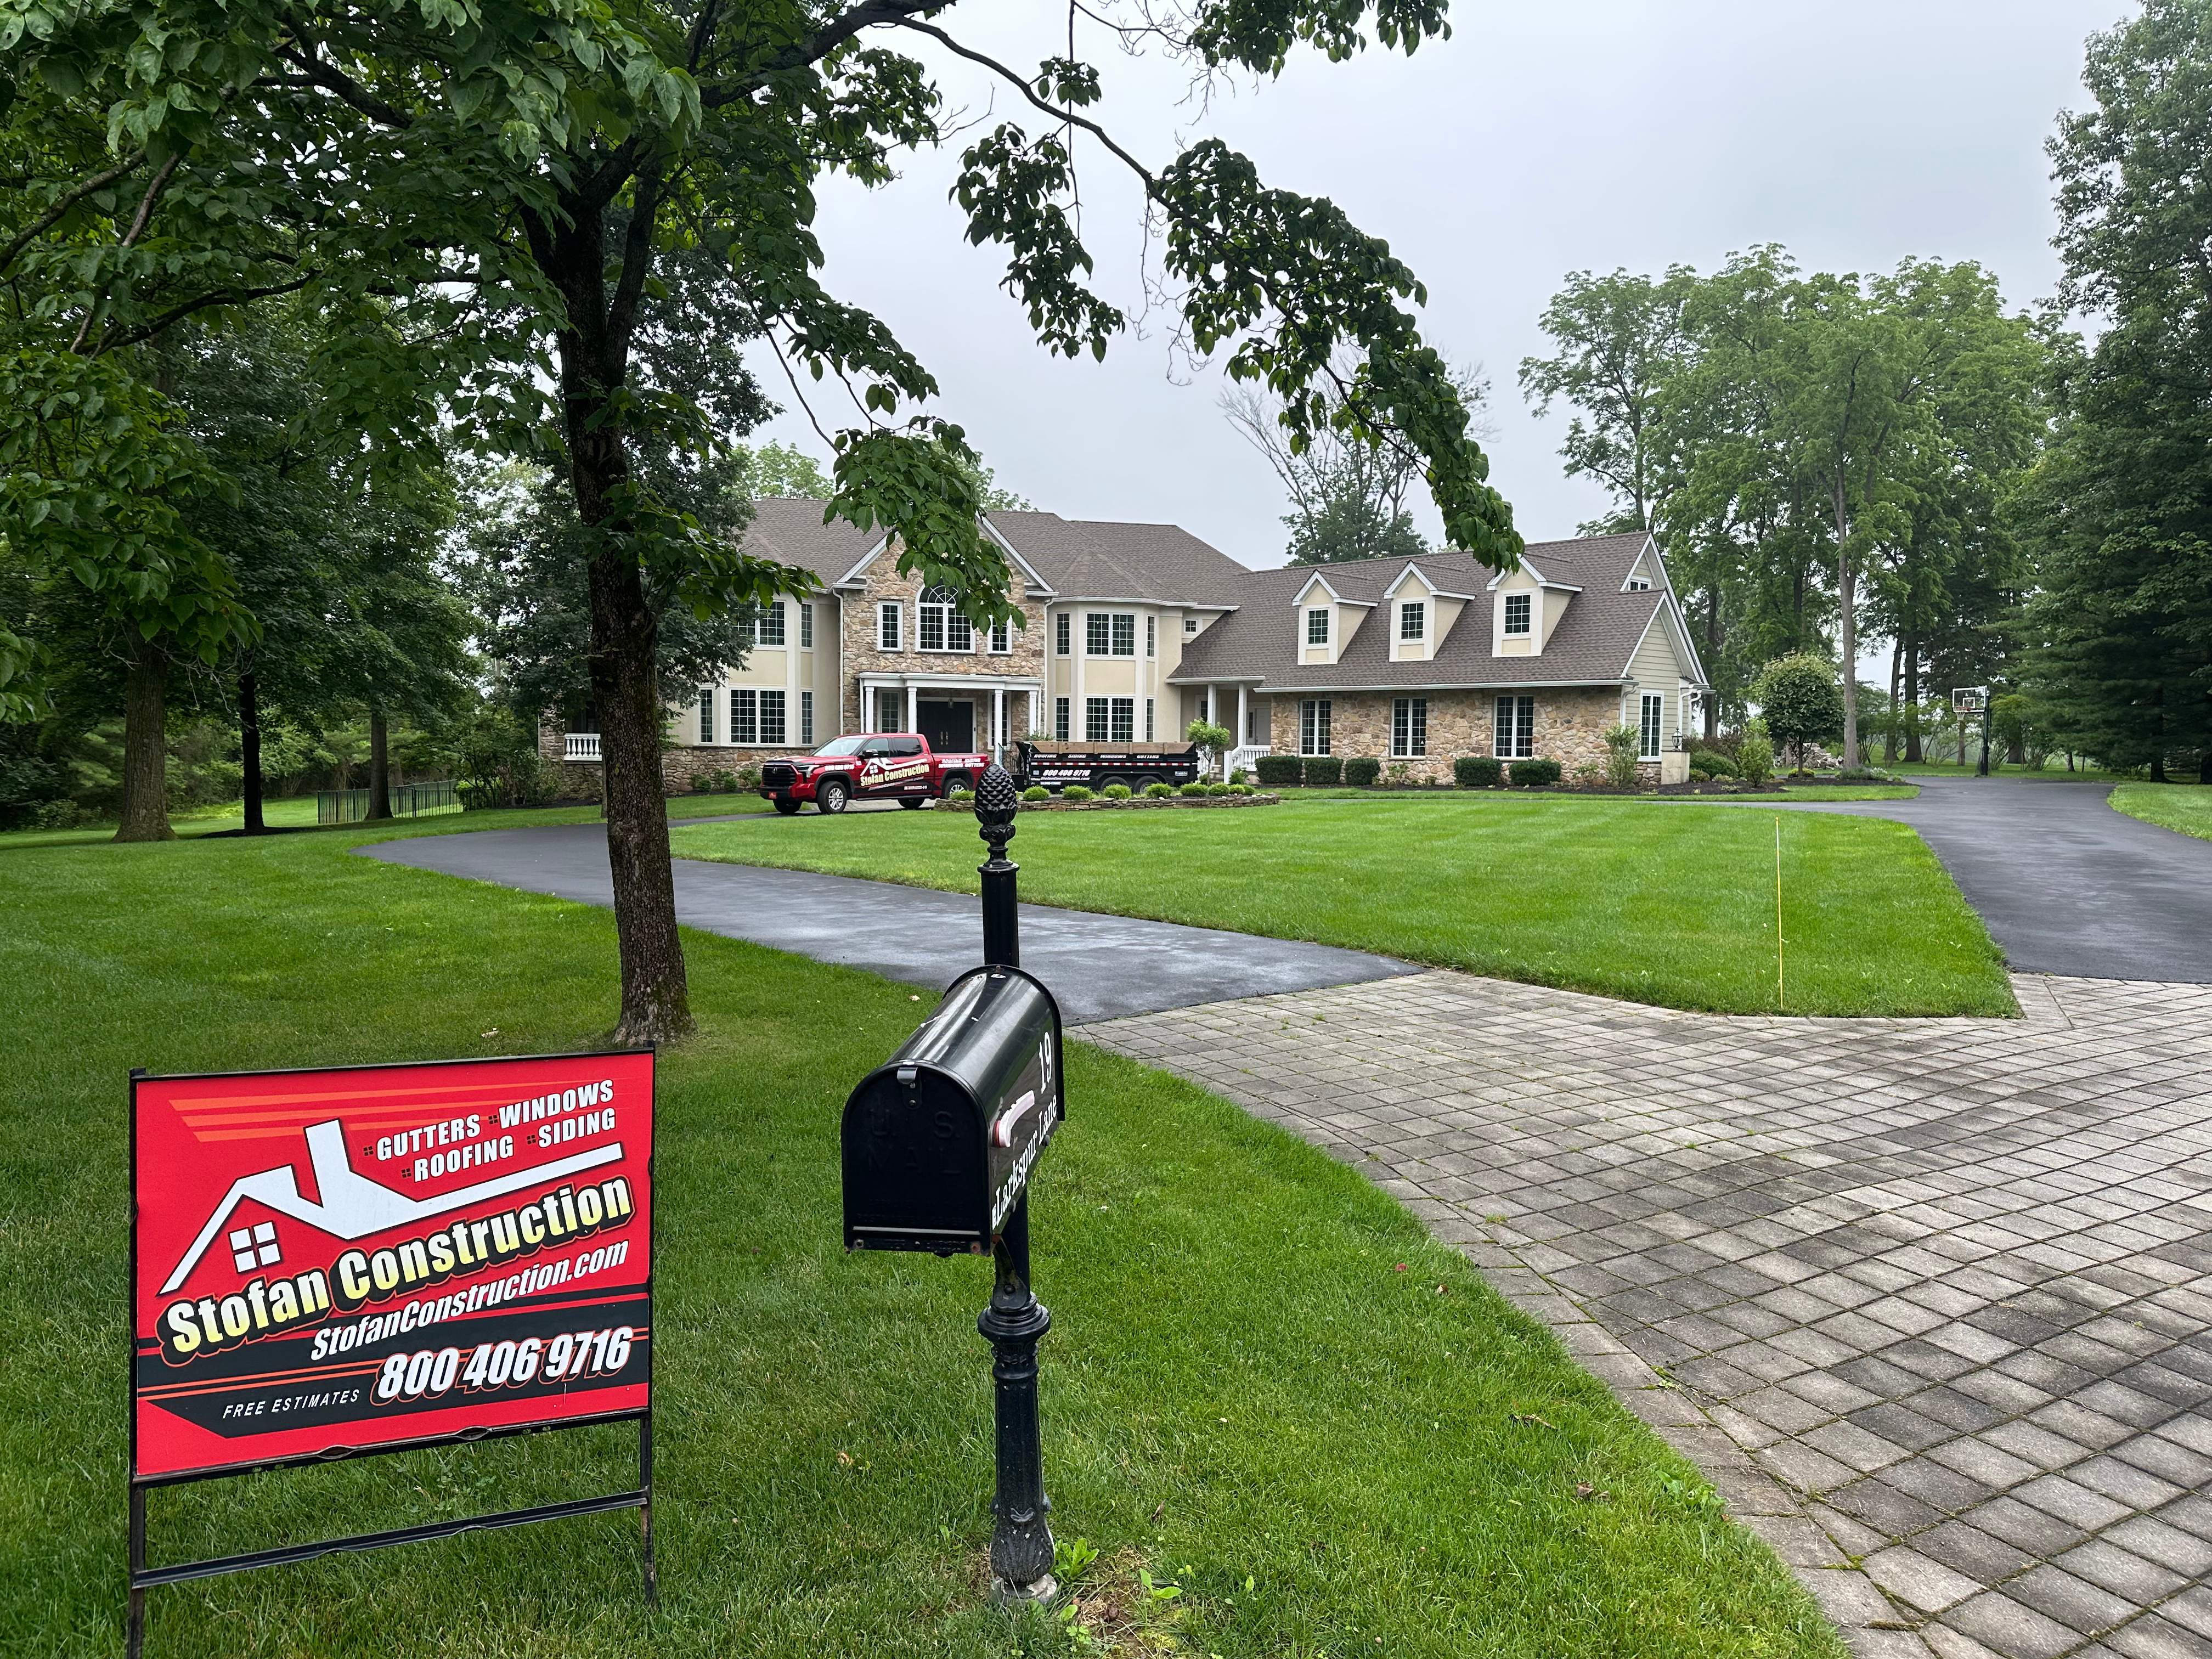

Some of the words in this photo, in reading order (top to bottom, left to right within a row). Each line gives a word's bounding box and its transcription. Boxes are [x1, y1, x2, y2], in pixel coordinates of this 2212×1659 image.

[860, 774, 884, 787] Stofan
[884, 764, 930, 782] Construction
[1039, 1032, 1052, 1094] 19
[376, 1114, 480, 1162] GUTTERS
[498, 1079, 613, 1130] WINDOWS
[413, 1137, 514, 1182] ROOFING
[537, 1108, 616, 1149] SIDING
[996, 1130, 1037, 1227] Larkspur
[1039, 1094, 1057, 1146] Lane
[170, 1268, 330, 1353] Stofan
[337, 1178, 633, 1300] Construction
[311, 1238, 629, 1361] StofanConstruction.com
[377, 1345, 459, 1398] 800
[462, 1338, 540, 1393] 406
[545, 1327, 633, 1378] 9716
[222, 1400, 266, 1420] FREE
[271, 1389, 359, 1414] ESTIMATES
